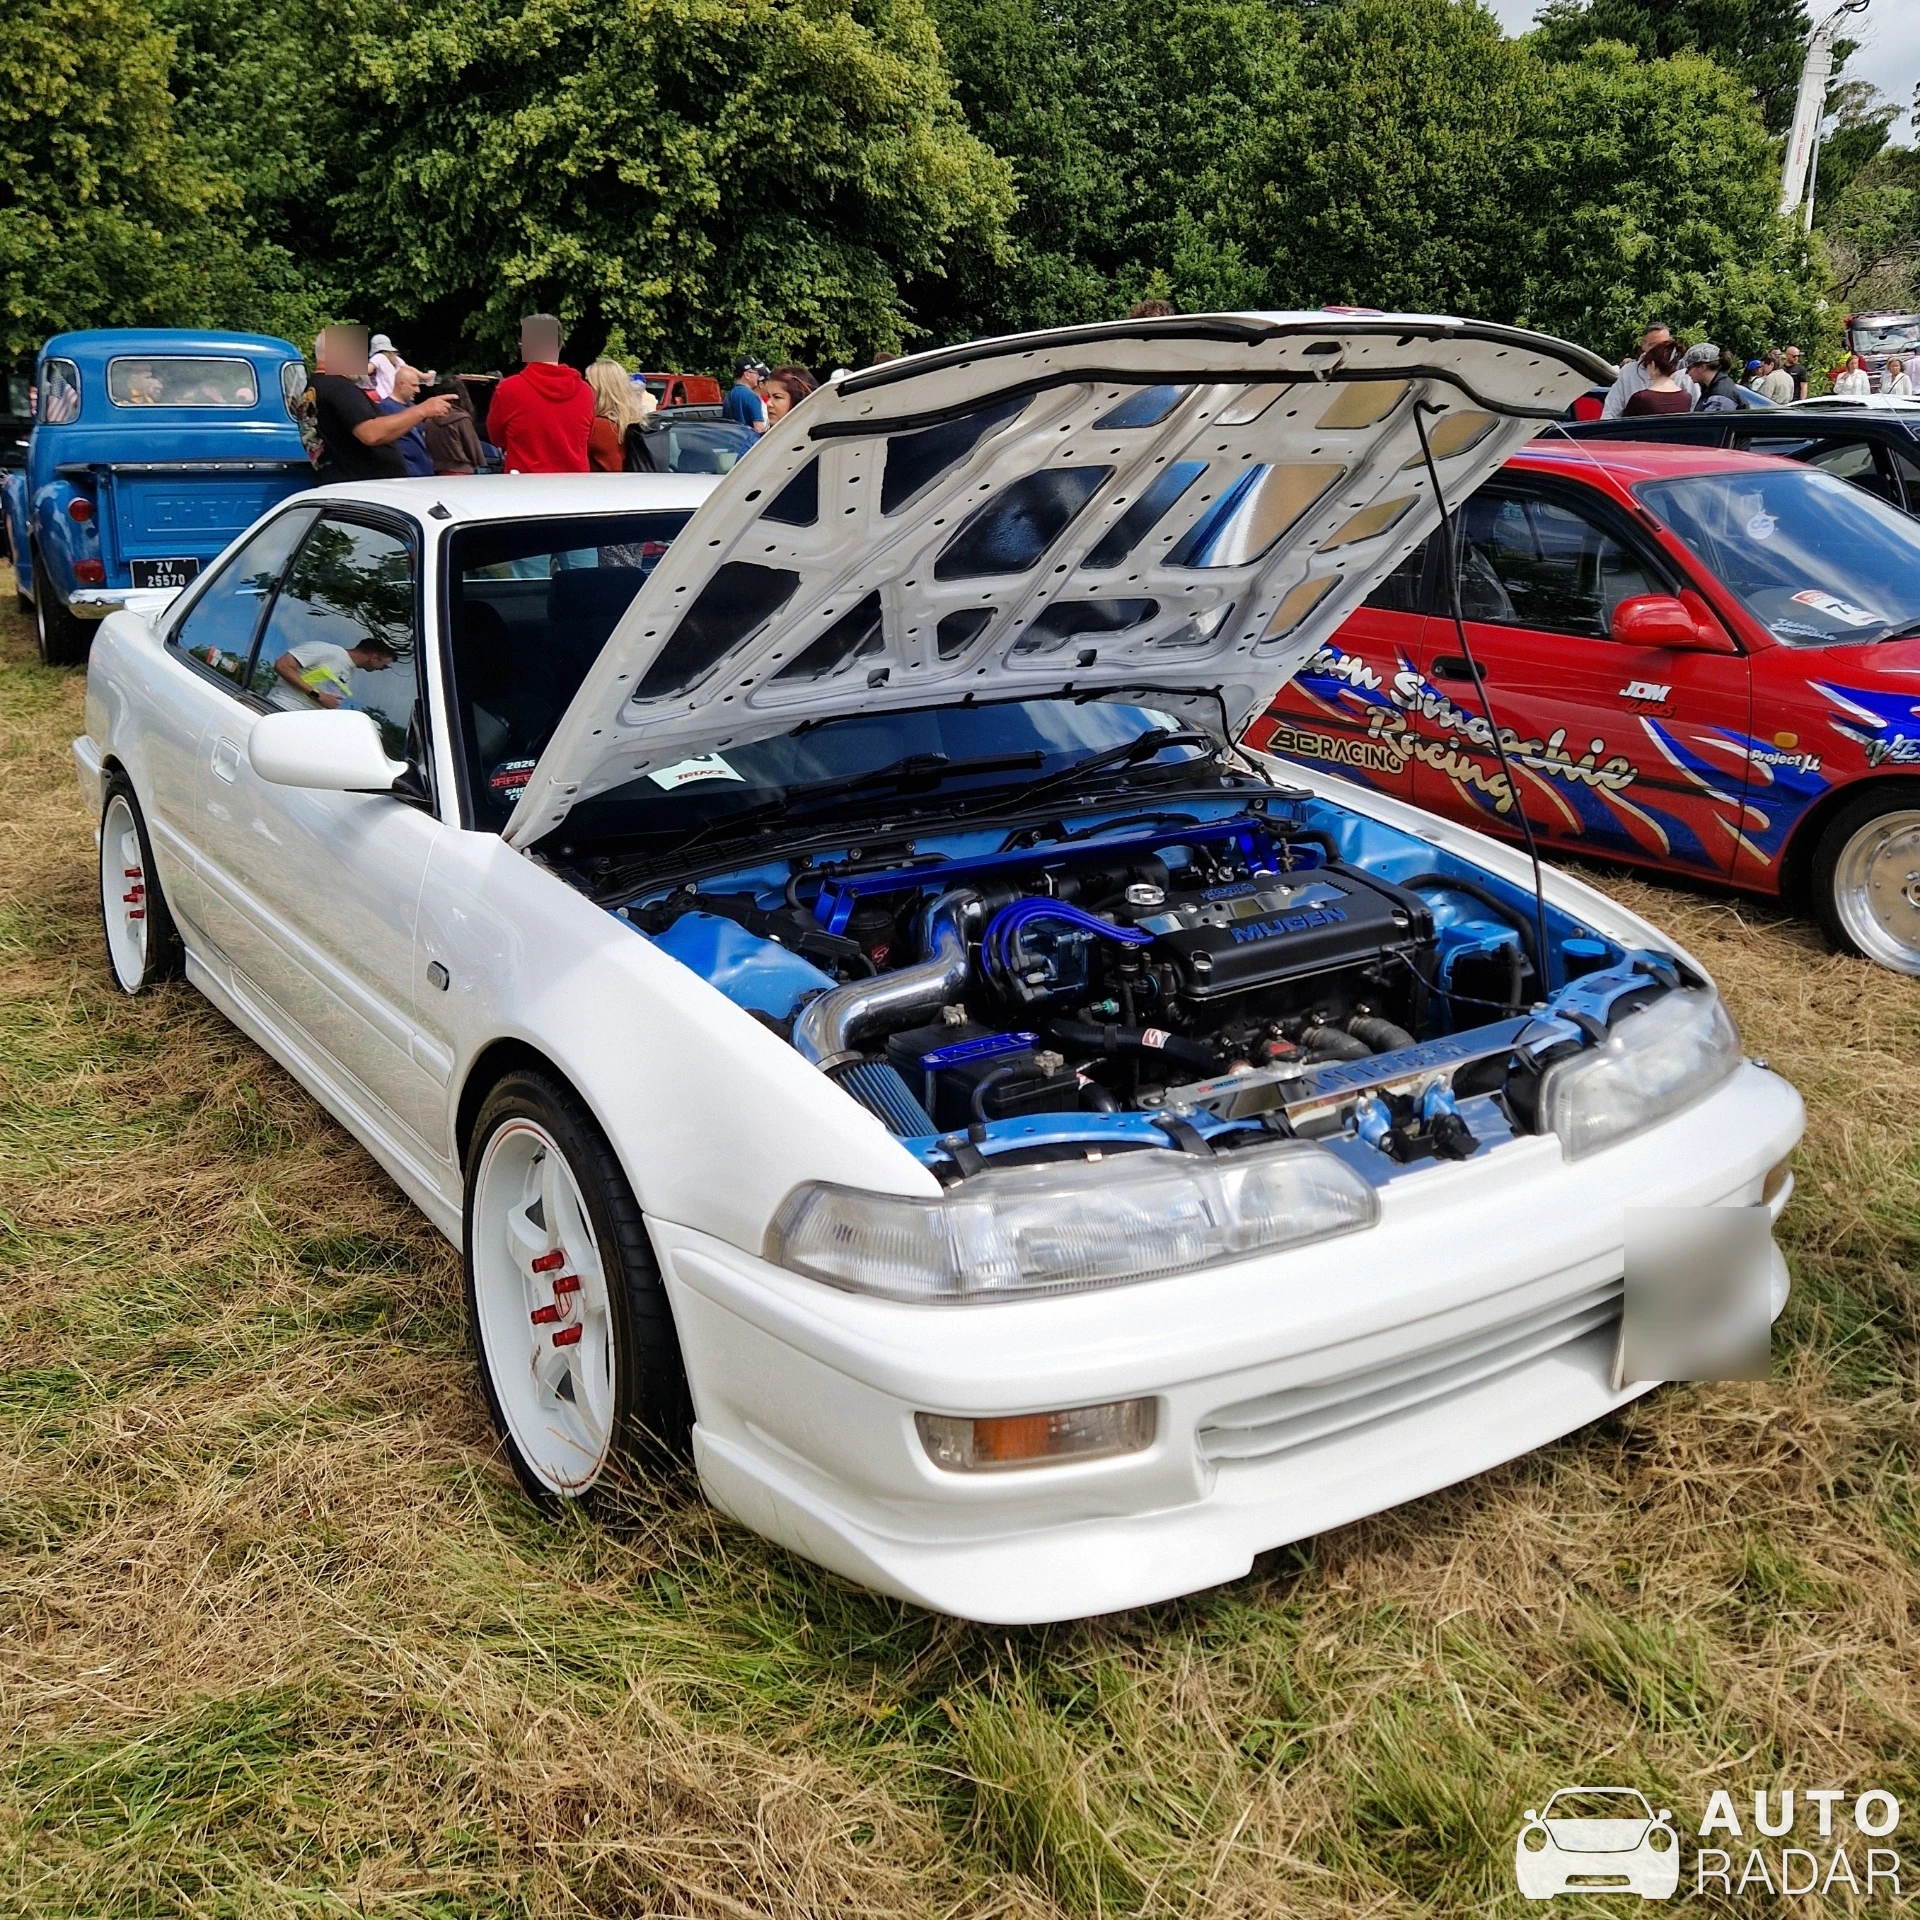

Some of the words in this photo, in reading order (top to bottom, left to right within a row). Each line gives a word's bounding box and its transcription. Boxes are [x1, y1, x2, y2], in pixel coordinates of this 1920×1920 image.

[157, 562, 173, 574] ZV
[147, 574, 186, 587] 25570
[1618, 681, 1673, 702] JDM
[1389, 672, 1639, 790] Smoochie
[505, 760, 536, 770] 2026
[1366, 706, 1522, 813] Racing
[1749, 749, 1802, 767] Project
[491, 773, 532, 788] JAPFE
[1229, 907, 1349, 944] MUGEN
[1301, 1041, 1472, 1092] INTEGRA
